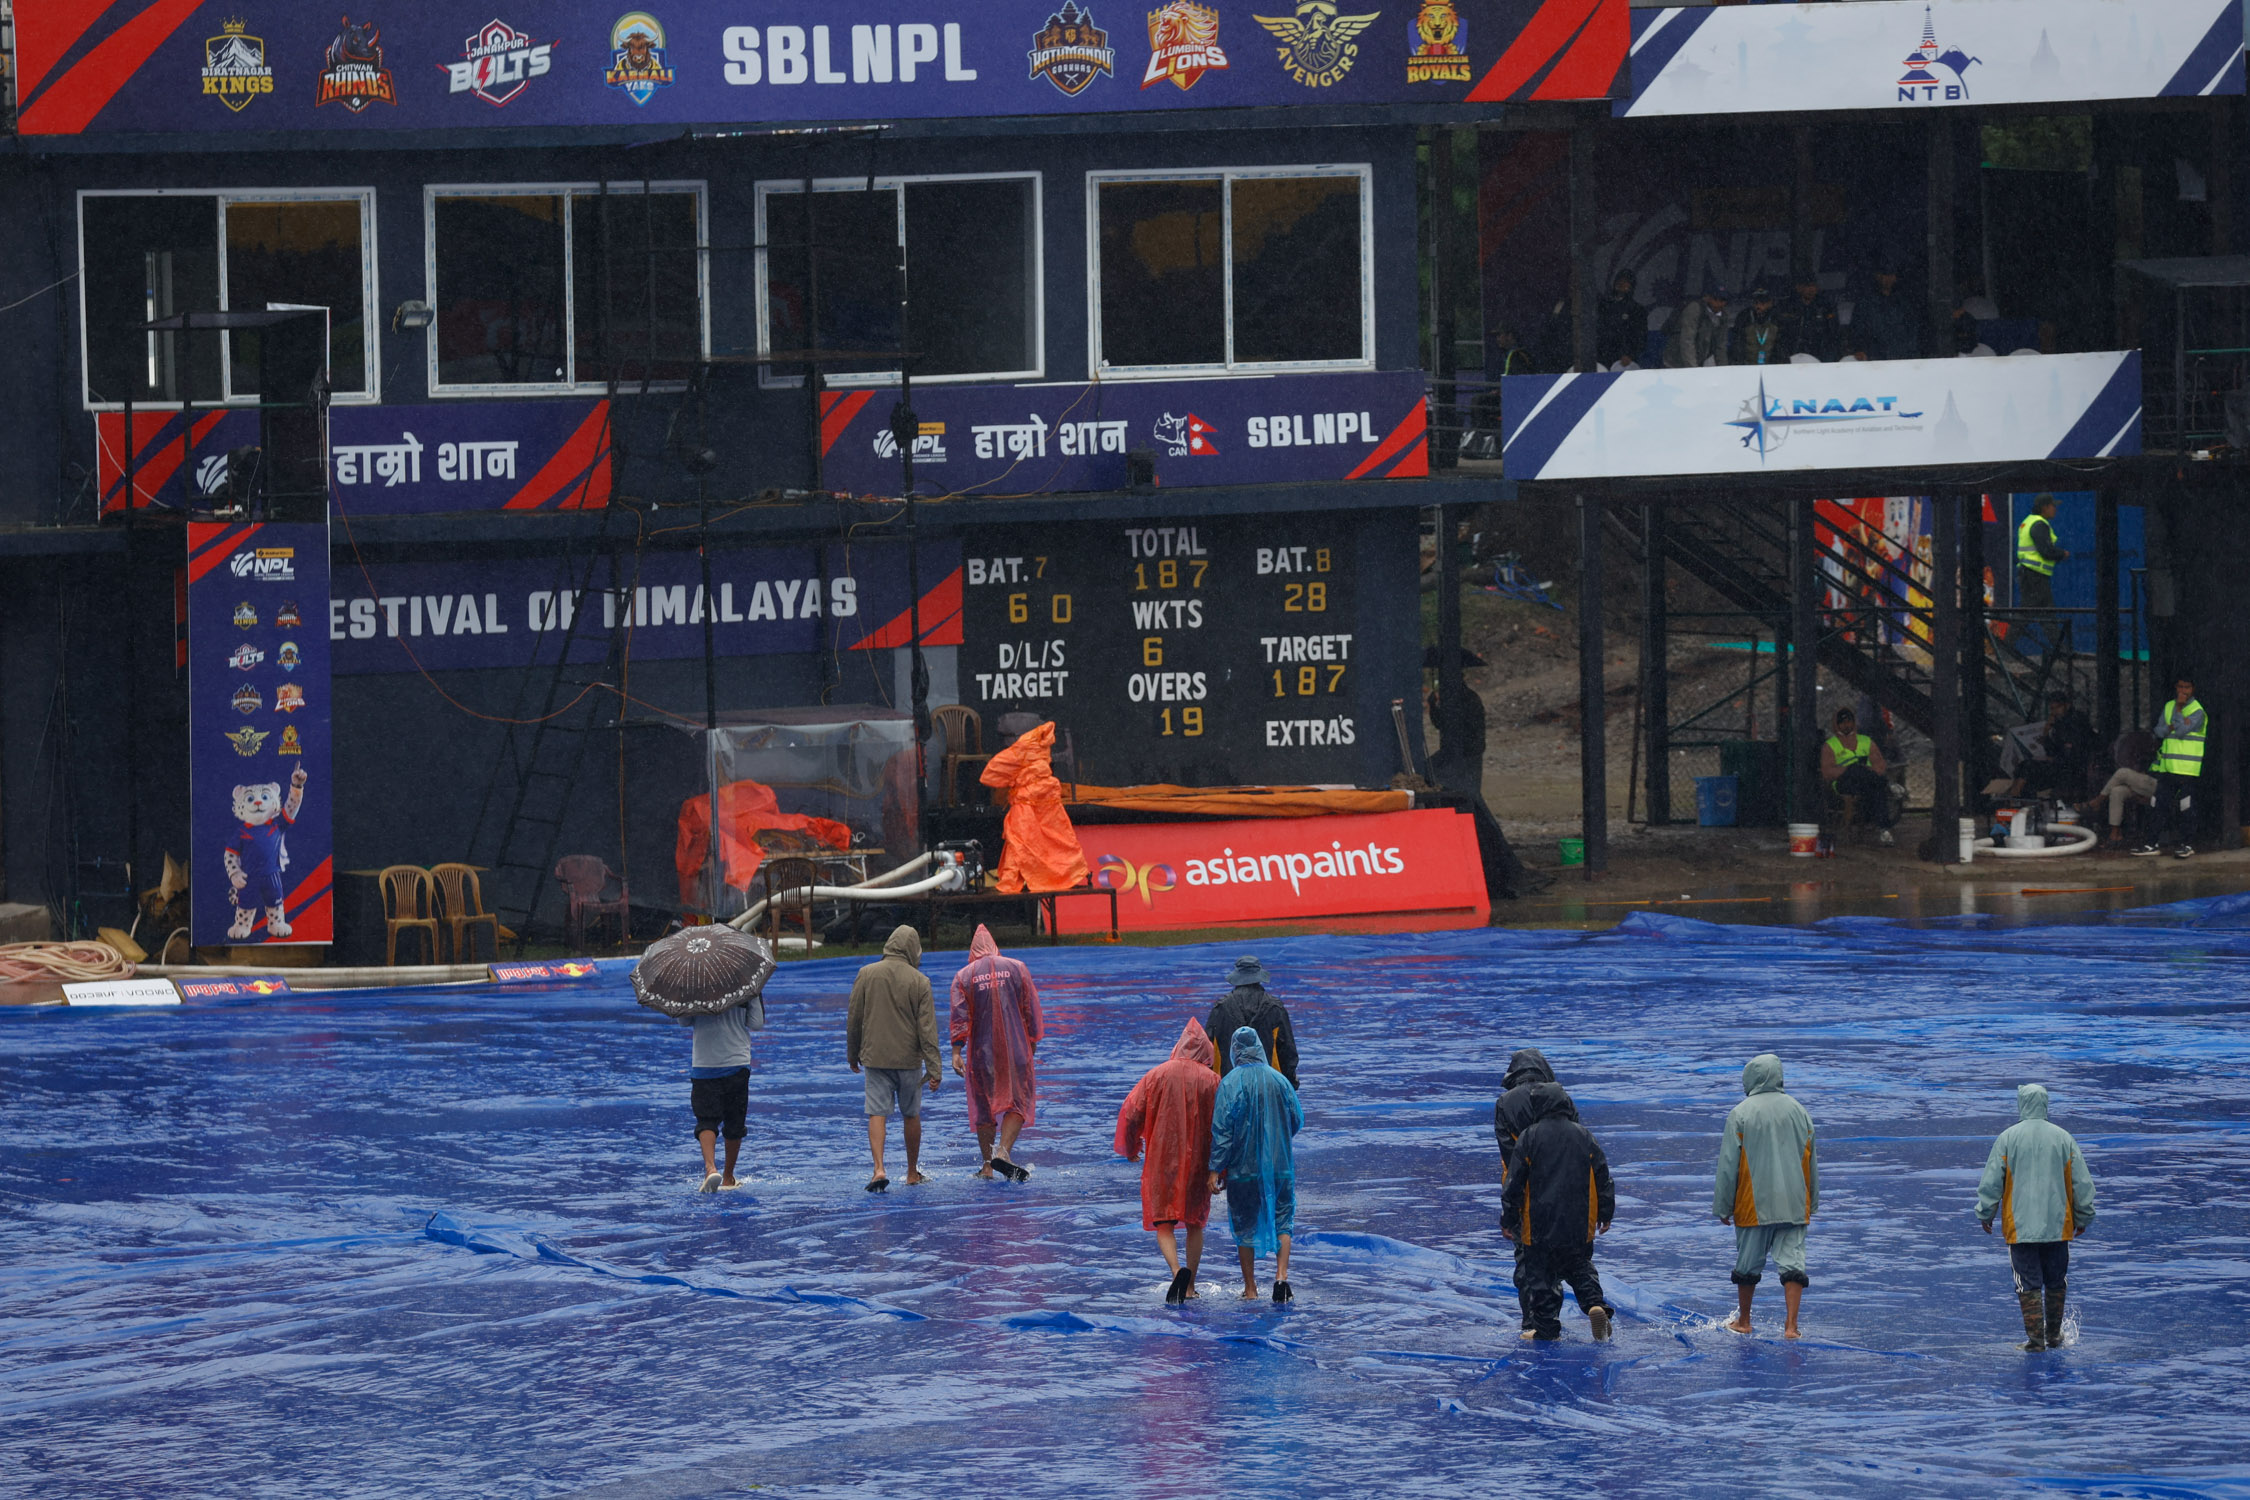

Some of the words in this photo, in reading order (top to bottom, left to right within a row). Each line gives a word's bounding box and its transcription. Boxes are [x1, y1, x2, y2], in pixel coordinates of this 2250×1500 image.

[470, 38, 524, 57] JANAKPUR
[723, 23, 977, 85] SBLNPL
[1032, 46, 1112, 72] KATHMANDU
[201, 66, 272, 76] BIRATNAGAR
[336, 63, 373, 73] CHITWAN
[447, 44, 551, 93] BOLTS
[606, 69, 673, 84] KARNALI
[1051, 63, 1091, 74] GORKHAS
[1276, 43, 1358, 87] AVENGERS
[1407, 64, 1471, 83] ROYALS
[202, 76, 274, 94] KINGS
[321, 72, 391, 101] RHINOS
[625, 81, 654, 91] YAKS
[1898, 85, 1960, 101] NTB
[1793, 396, 1897, 414] NAAT
[971, 413, 1048, 461] हाम्रो
[1060, 421, 1128, 456] शान
[1247, 411, 1379, 448] SBLNPL
[333, 432, 423, 487] हाम्रो
[438, 441, 519, 481] शान
[1168, 447, 1188, 457] CAN
[1124, 527, 1207, 558] TOTAL
[254, 558, 294, 573] NPL
[968, 557, 1029, 585] BAT.
[1035, 557, 1048, 579] 7
[1256, 546, 1312, 575] BAT.
[1316, 548, 1331, 573] 8
[1284, 582, 1327, 612] 28
[330, 593, 508, 640] ESTIVAL
[1132, 599, 1203, 630] WKTS
[998, 639, 1065, 670] D/L/S
[1143, 636, 1163, 667] 6
[1260, 634, 1352, 663] TARGET
[975, 670, 1069, 700] TARGET
[1128, 671, 1207, 702] OVERS
[1160, 706, 1204, 736] 19
[1266, 714, 1355, 746] EXTRA'S
[1185, 840, 1405, 897] asianpaints
[496, 967, 526, 980] Bull
[523, 966, 550, 978] Red
[972, 970, 1011, 983] GROUND
[979, 979, 1006, 991] STAFF
[183, 984, 213, 997] Bull
[210, 983, 239, 996] Red
